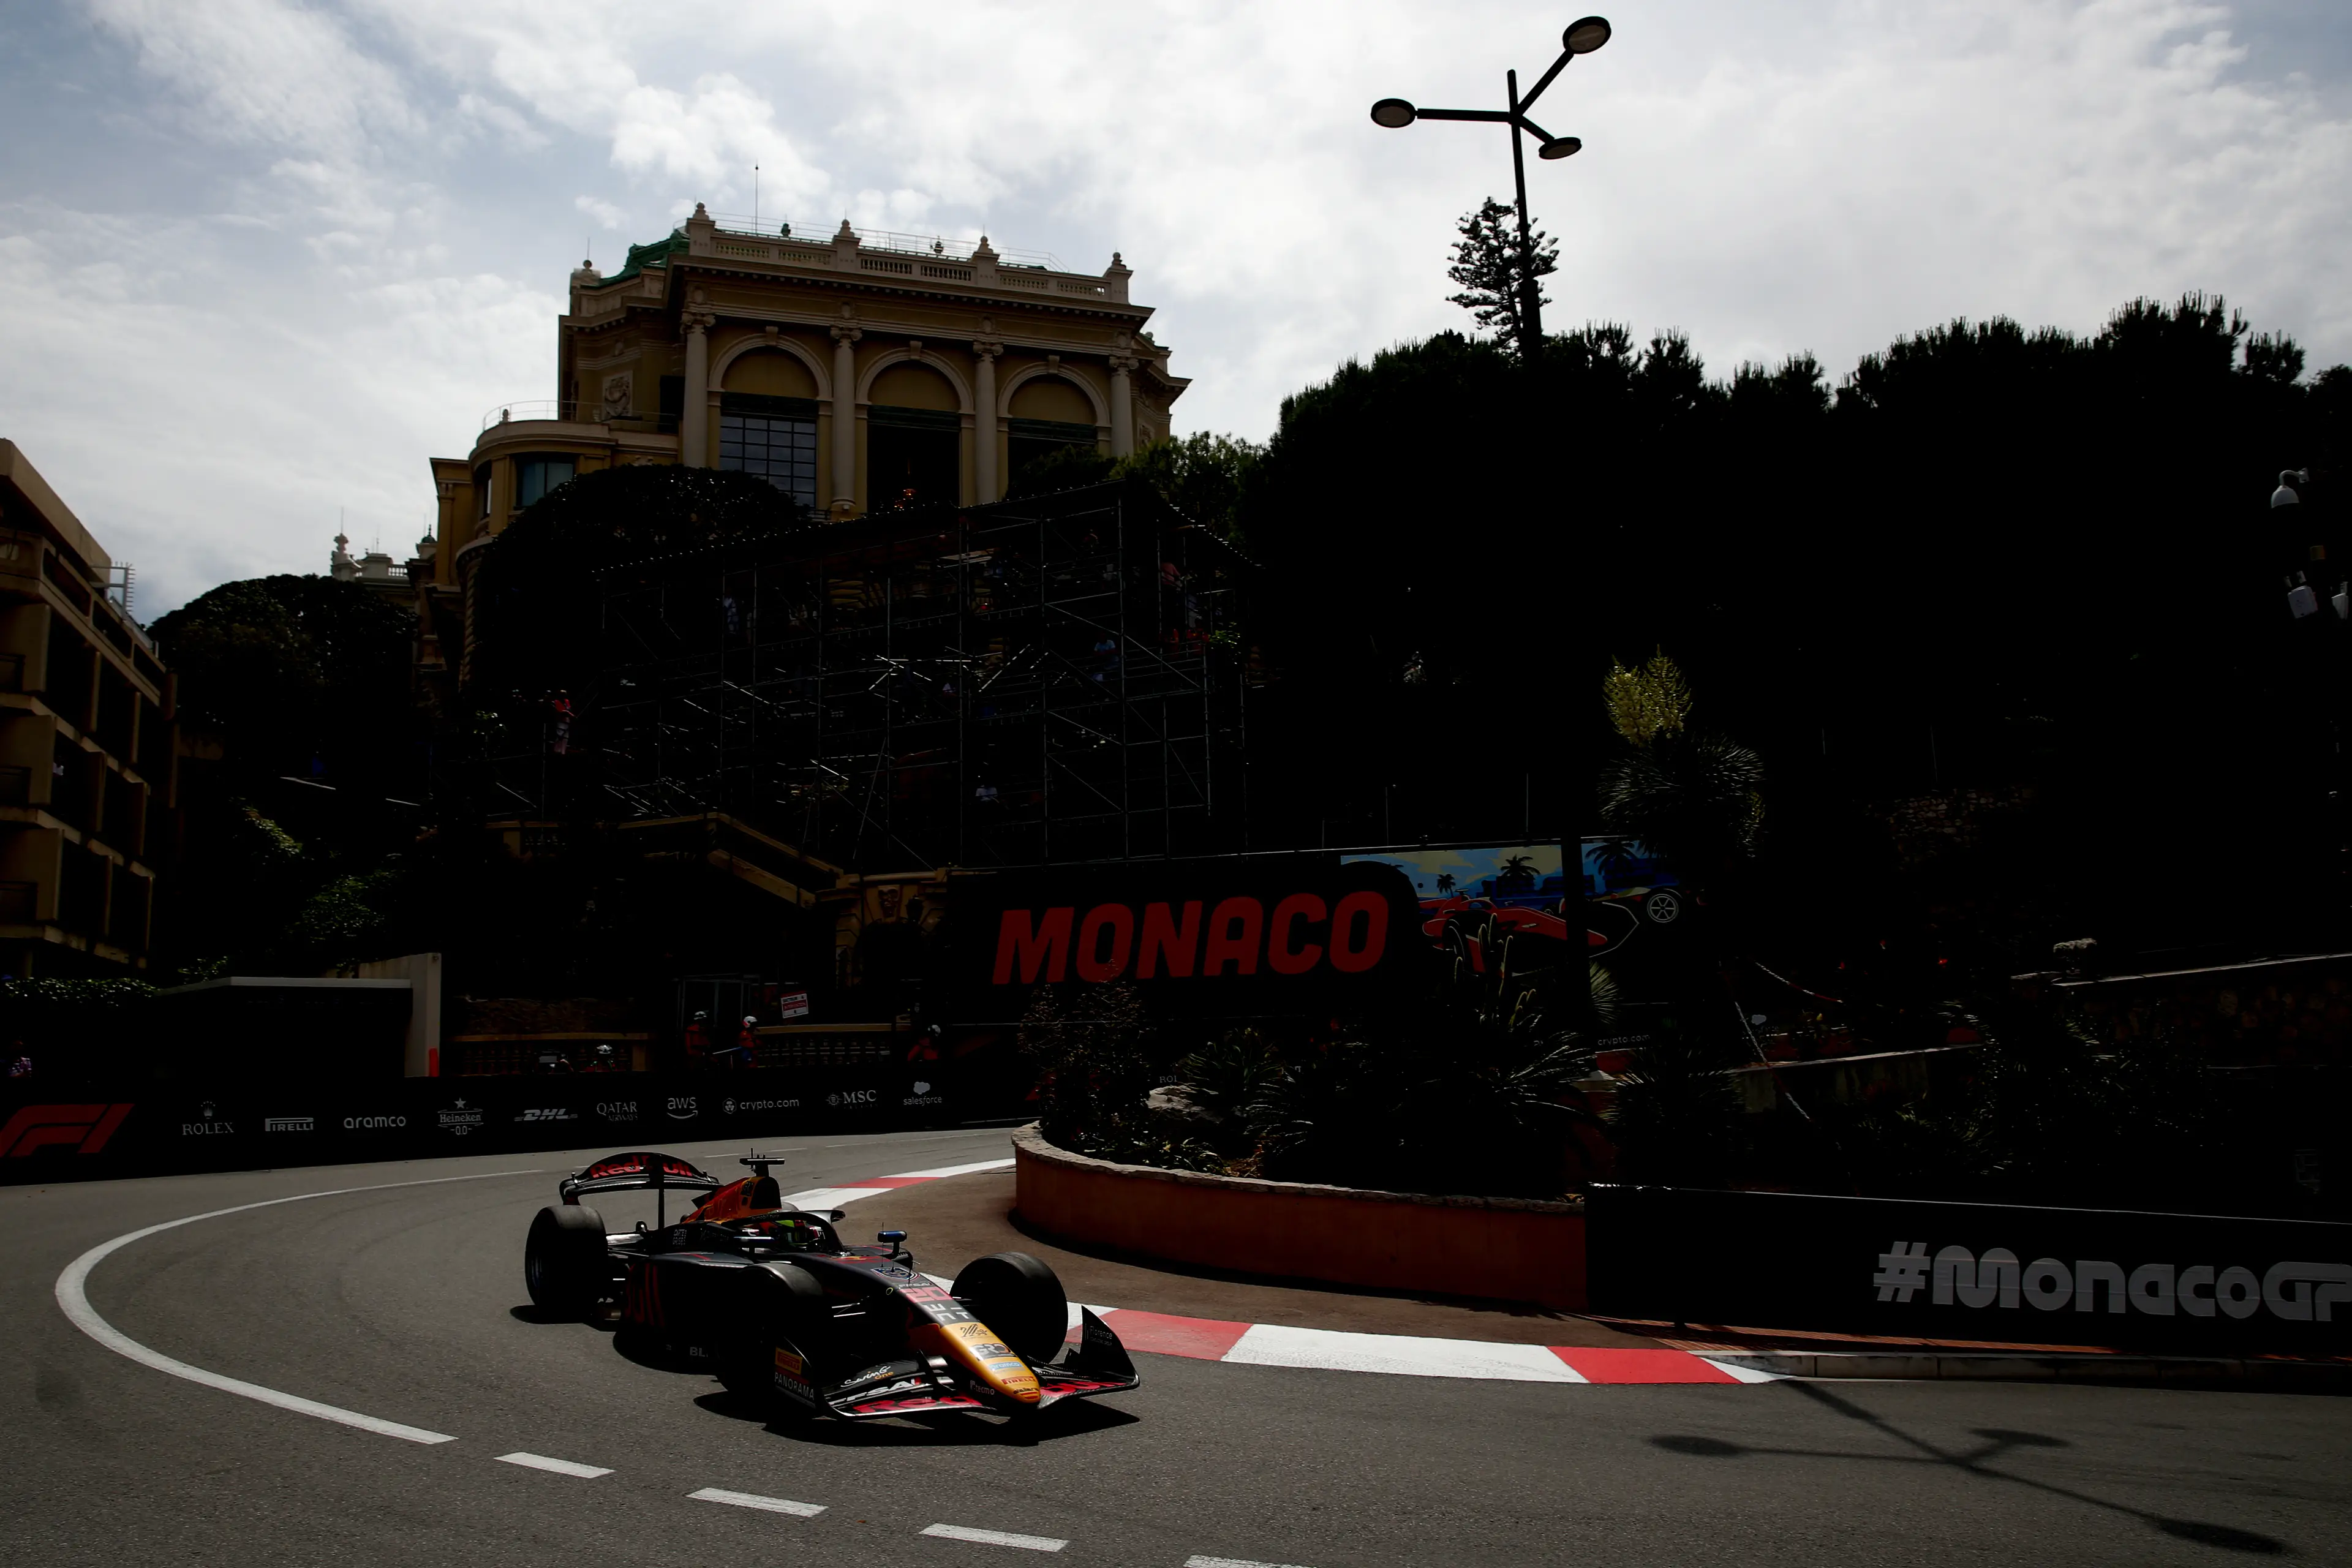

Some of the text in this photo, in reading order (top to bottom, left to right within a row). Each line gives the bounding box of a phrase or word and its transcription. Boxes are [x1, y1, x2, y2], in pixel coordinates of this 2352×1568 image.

[991, 891, 1389, 985] MONACO
[1597, 1033, 1651, 1046] crypto.com
[667, 1096, 697, 1110] aws
[739, 1097, 800, 1112] crypto.com
[842, 1090, 877, 1104] MSC
[903, 1095, 943, 1107] salesforce
[522, 1108, 571, 1121] DHL
[596, 1101, 638, 1115] QATAR
[265, 1117, 314, 1132] PIRELLI
[343, 1114, 407, 1129] aramco
[439, 1112, 482, 1123] Heineken
[0, 1102, 136, 1159] F1
[182, 1121, 235, 1136] ROLEX
[1089, 1325, 1113, 1340] Florence
[774, 1371, 815, 1401] PANORAMA
